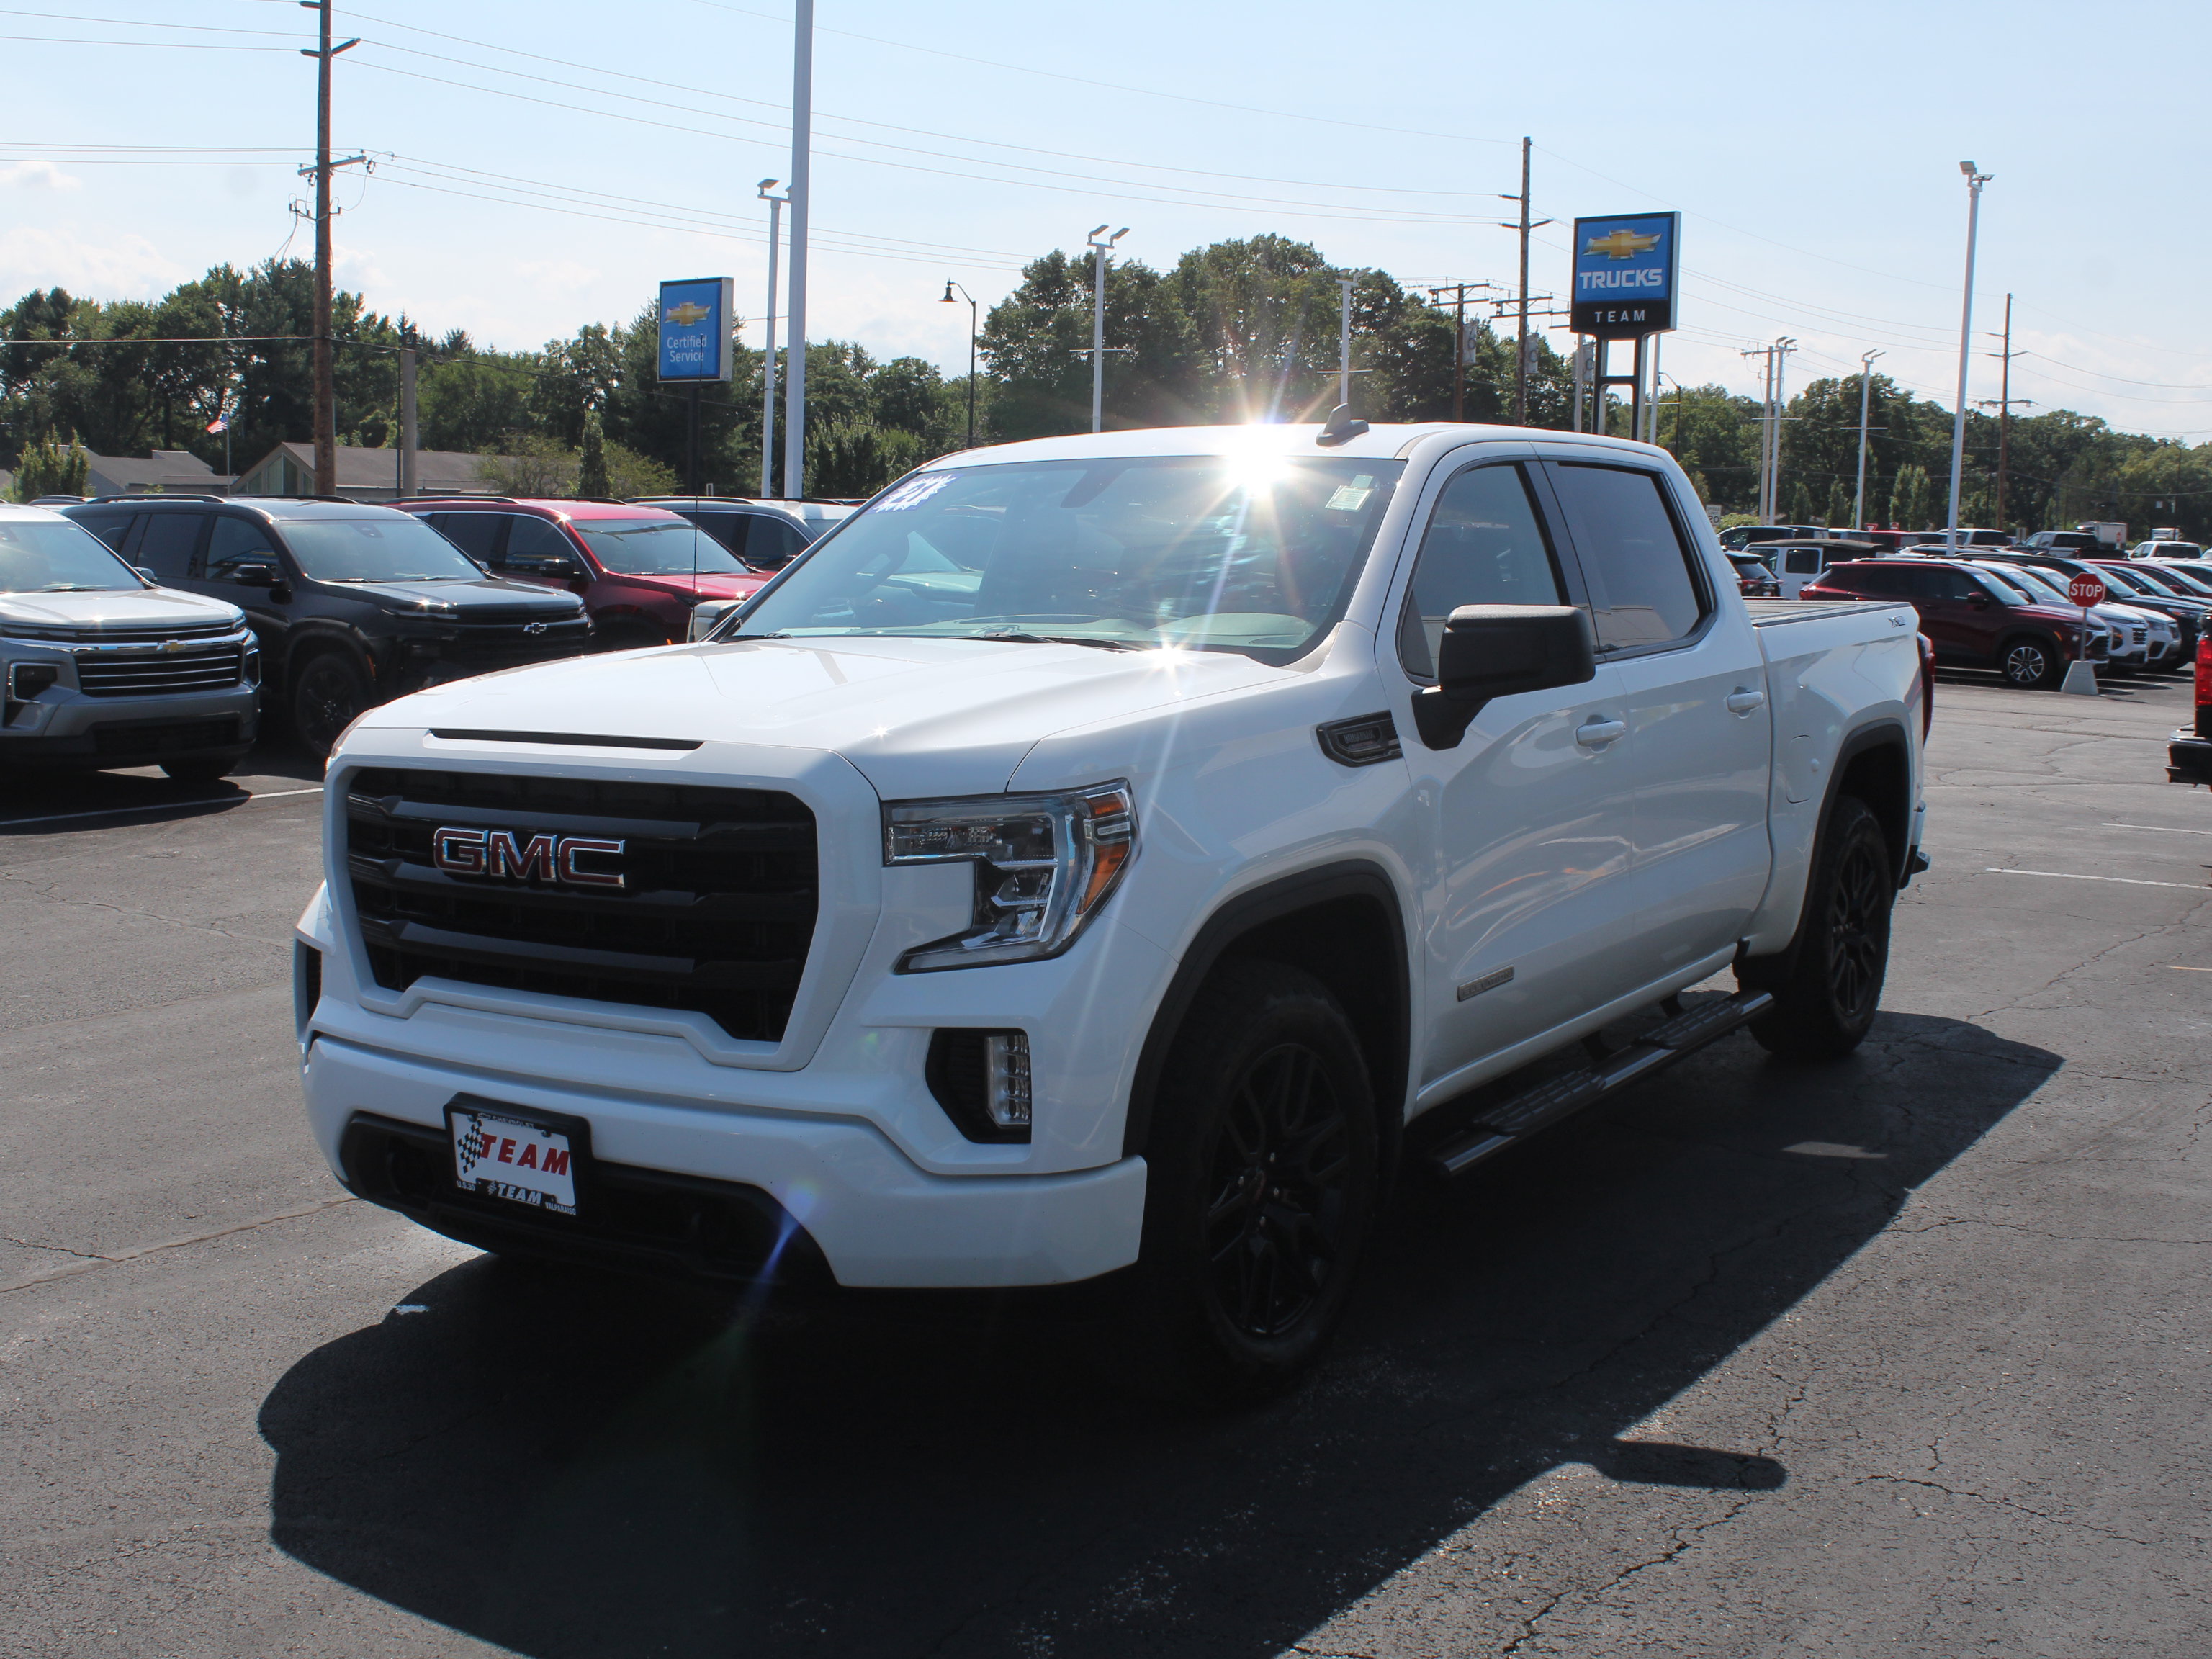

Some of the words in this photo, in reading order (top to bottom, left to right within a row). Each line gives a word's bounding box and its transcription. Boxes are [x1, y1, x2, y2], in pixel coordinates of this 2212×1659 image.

[1579, 268, 1663, 289] TRUCKS
[1595, 310, 1646, 323] TEAM
[667, 335, 707, 348] Certified
[670, 351, 704, 362] Service
[2069, 583, 2103, 597] STOP
[433, 826, 625, 888] GMC
[480, 1133, 570, 1176] TEAM
[498, 1183, 542, 1205] TEAM
[545, 1202, 576, 1215] VALPARAISO
